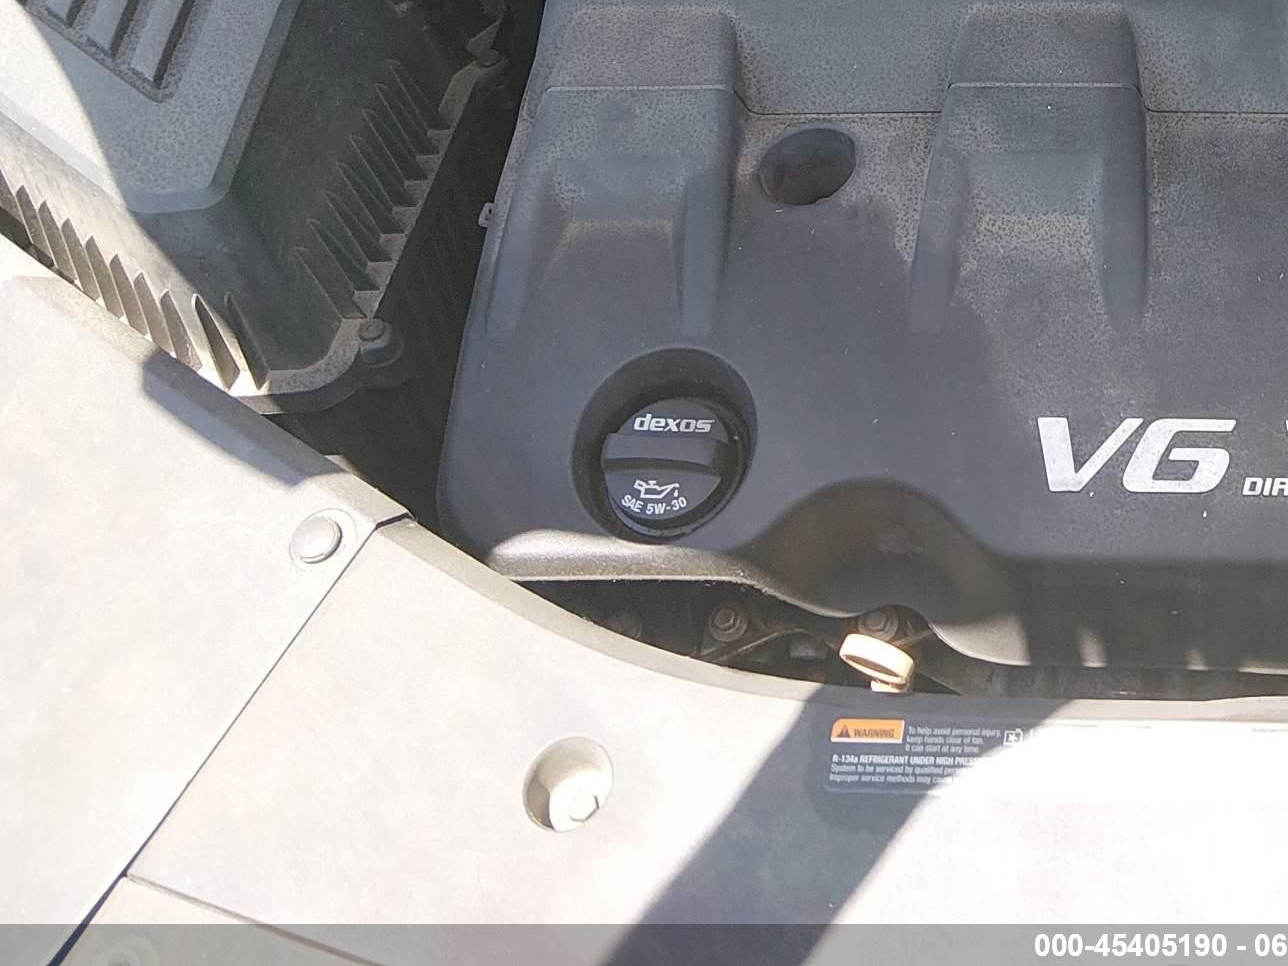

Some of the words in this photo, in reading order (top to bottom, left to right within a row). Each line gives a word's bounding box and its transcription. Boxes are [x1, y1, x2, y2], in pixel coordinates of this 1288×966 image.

[633, 414, 715, 433] dexos
[1037, 416, 1238, 493] V6
[621, 494, 644, 513] SAE
[645, 496, 688, 515] 5W-30
[854, 728, 895, 739] WARNING
[832, 753, 858, 764] R-134a
[859, 754, 909, 765] REFRIGERANT
[910, 755, 935, 765] UNDER
[936, 756, 954, 765] HIGH
